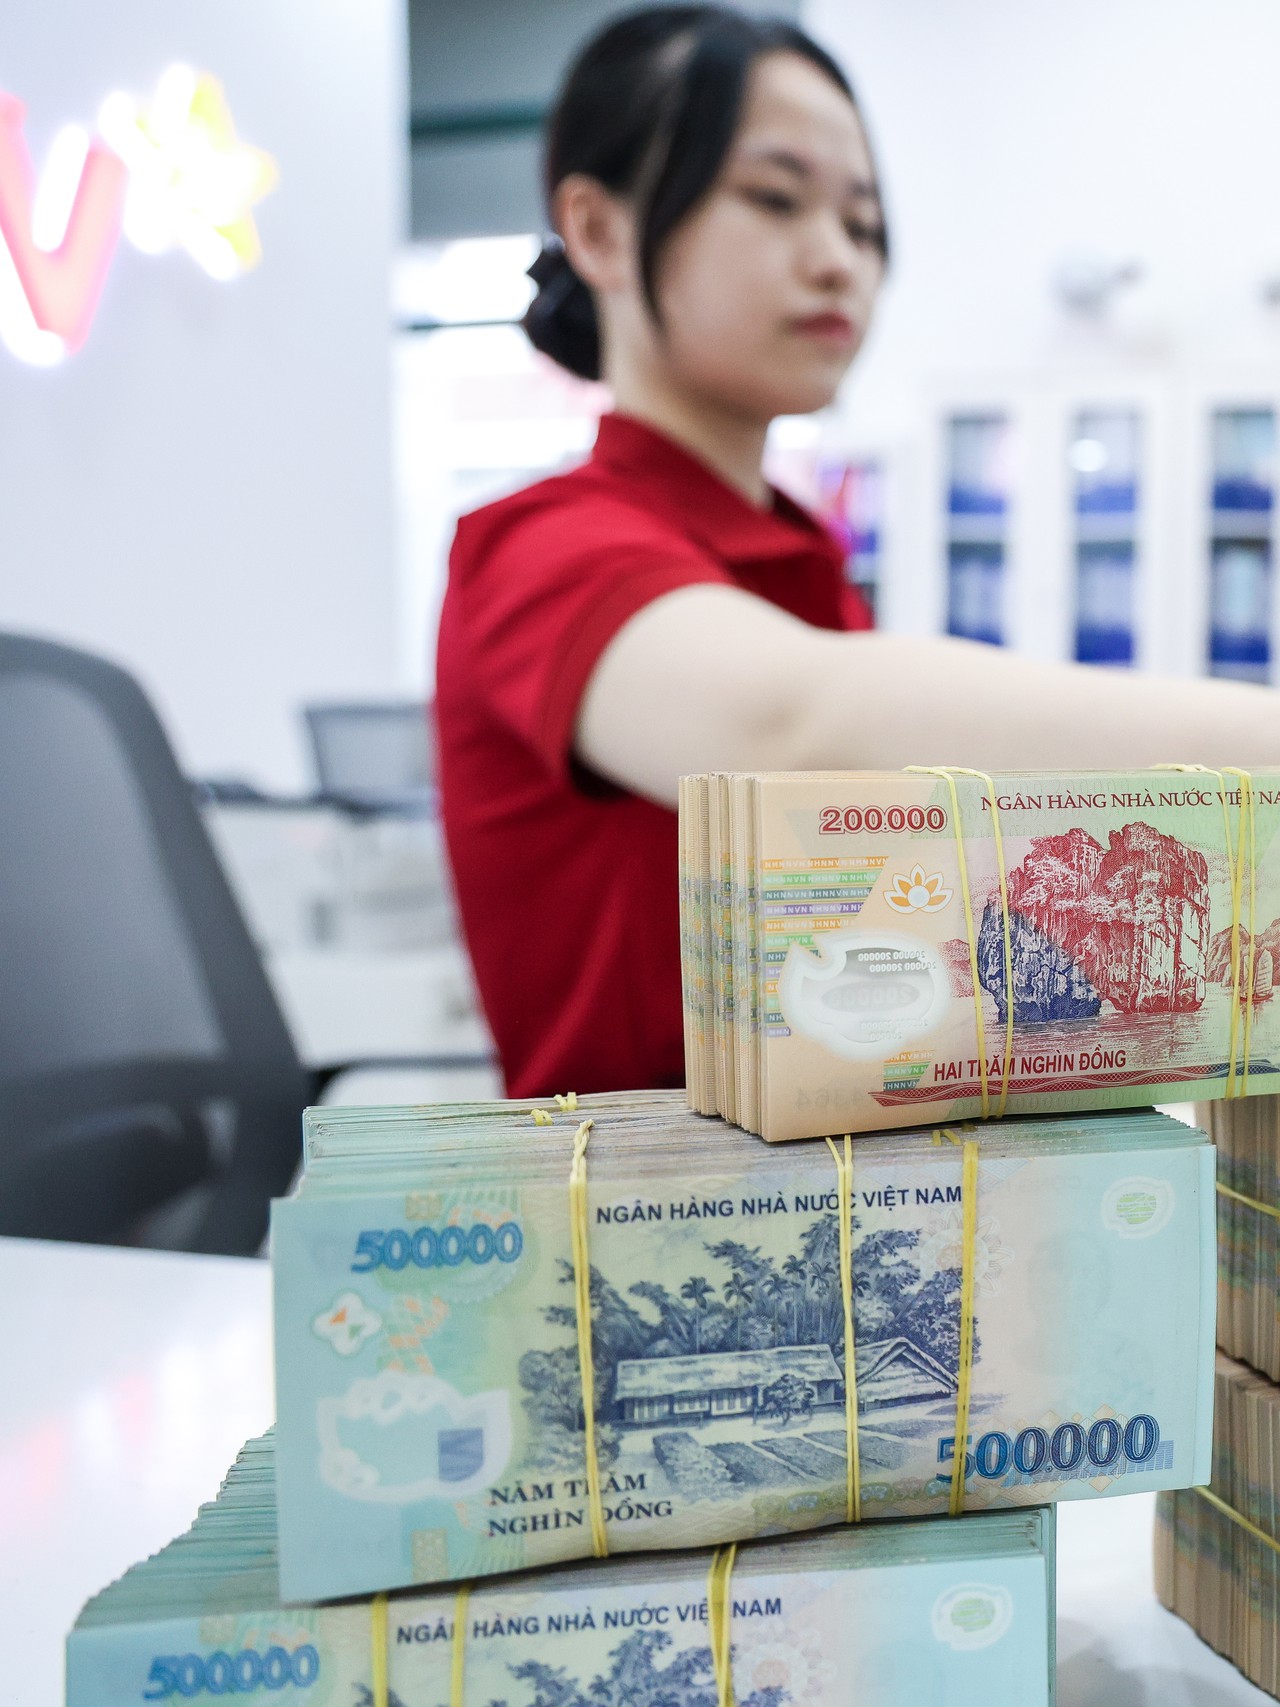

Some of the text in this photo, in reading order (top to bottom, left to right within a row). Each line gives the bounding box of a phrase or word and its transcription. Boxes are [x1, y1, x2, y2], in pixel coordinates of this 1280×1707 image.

[1047, 790, 1107, 809] HÀNG
[1111, 788, 1155, 807] NHÀ
[1159, 787, 1213, 807] NƯỚC
[934, 1061, 962, 1081] HAI
[1020, 1050, 1076, 1075] NGHÌN
[1079, 1044, 1127, 1071] ĐỒNG
[596, 1199, 662, 1224] NGÂN
[669, 1196, 734, 1220] HÀNG
[741, 1191, 788, 1215] NHÀ
[862, 1184, 910, 1210] VIỆT
[916, 1185, 963, 1204] NAM
[489, 1479, 554, 1506] NĂM
[488, 1508, 584, 1536] NGHÌN
[473, 1613, 540, 1639] HÀNG
[547, 1606, 596, 1633] NHÀ
[604, 1601, 670, 1629] NƯỚC
[676, 1596, 710, 1623] VIỆ
[733, 1597, 782, 1617] NAM
